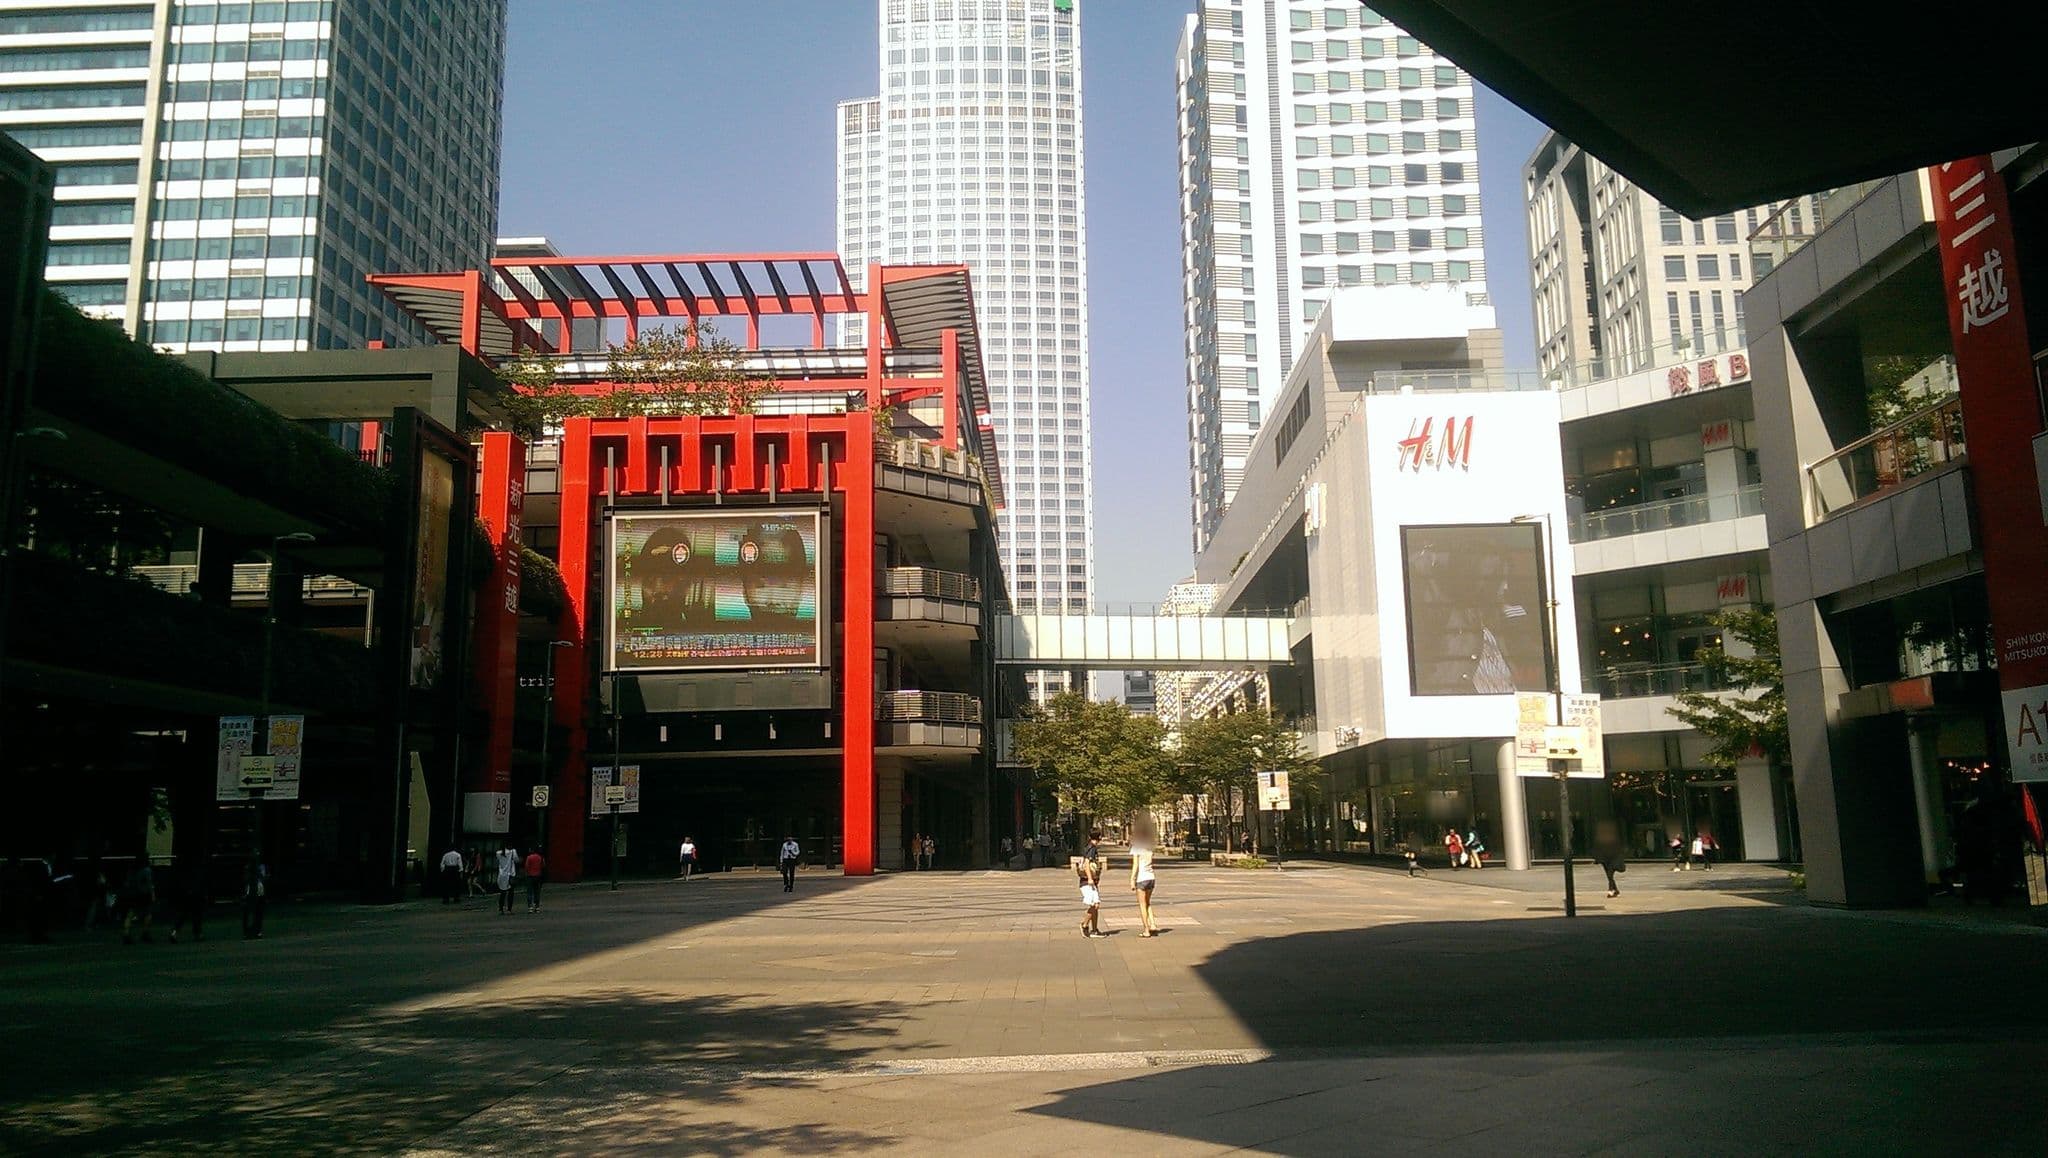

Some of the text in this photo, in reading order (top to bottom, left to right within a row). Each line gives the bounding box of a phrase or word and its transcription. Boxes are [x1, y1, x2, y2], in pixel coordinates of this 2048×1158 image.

[1943, 162, 2009, 334] 三越
[1397, 415, 1474, 471] H&M
[1701, 422, 1728, 445] H&M
[504, 479, 522, 614] 新光三越
[1717, 577, 1746, 599] H&M
[2006, 634, 2029, 649] SHIN
[2004, 645, 2048, 661] MITSUKO
[495, 797, 507, 815] A8
